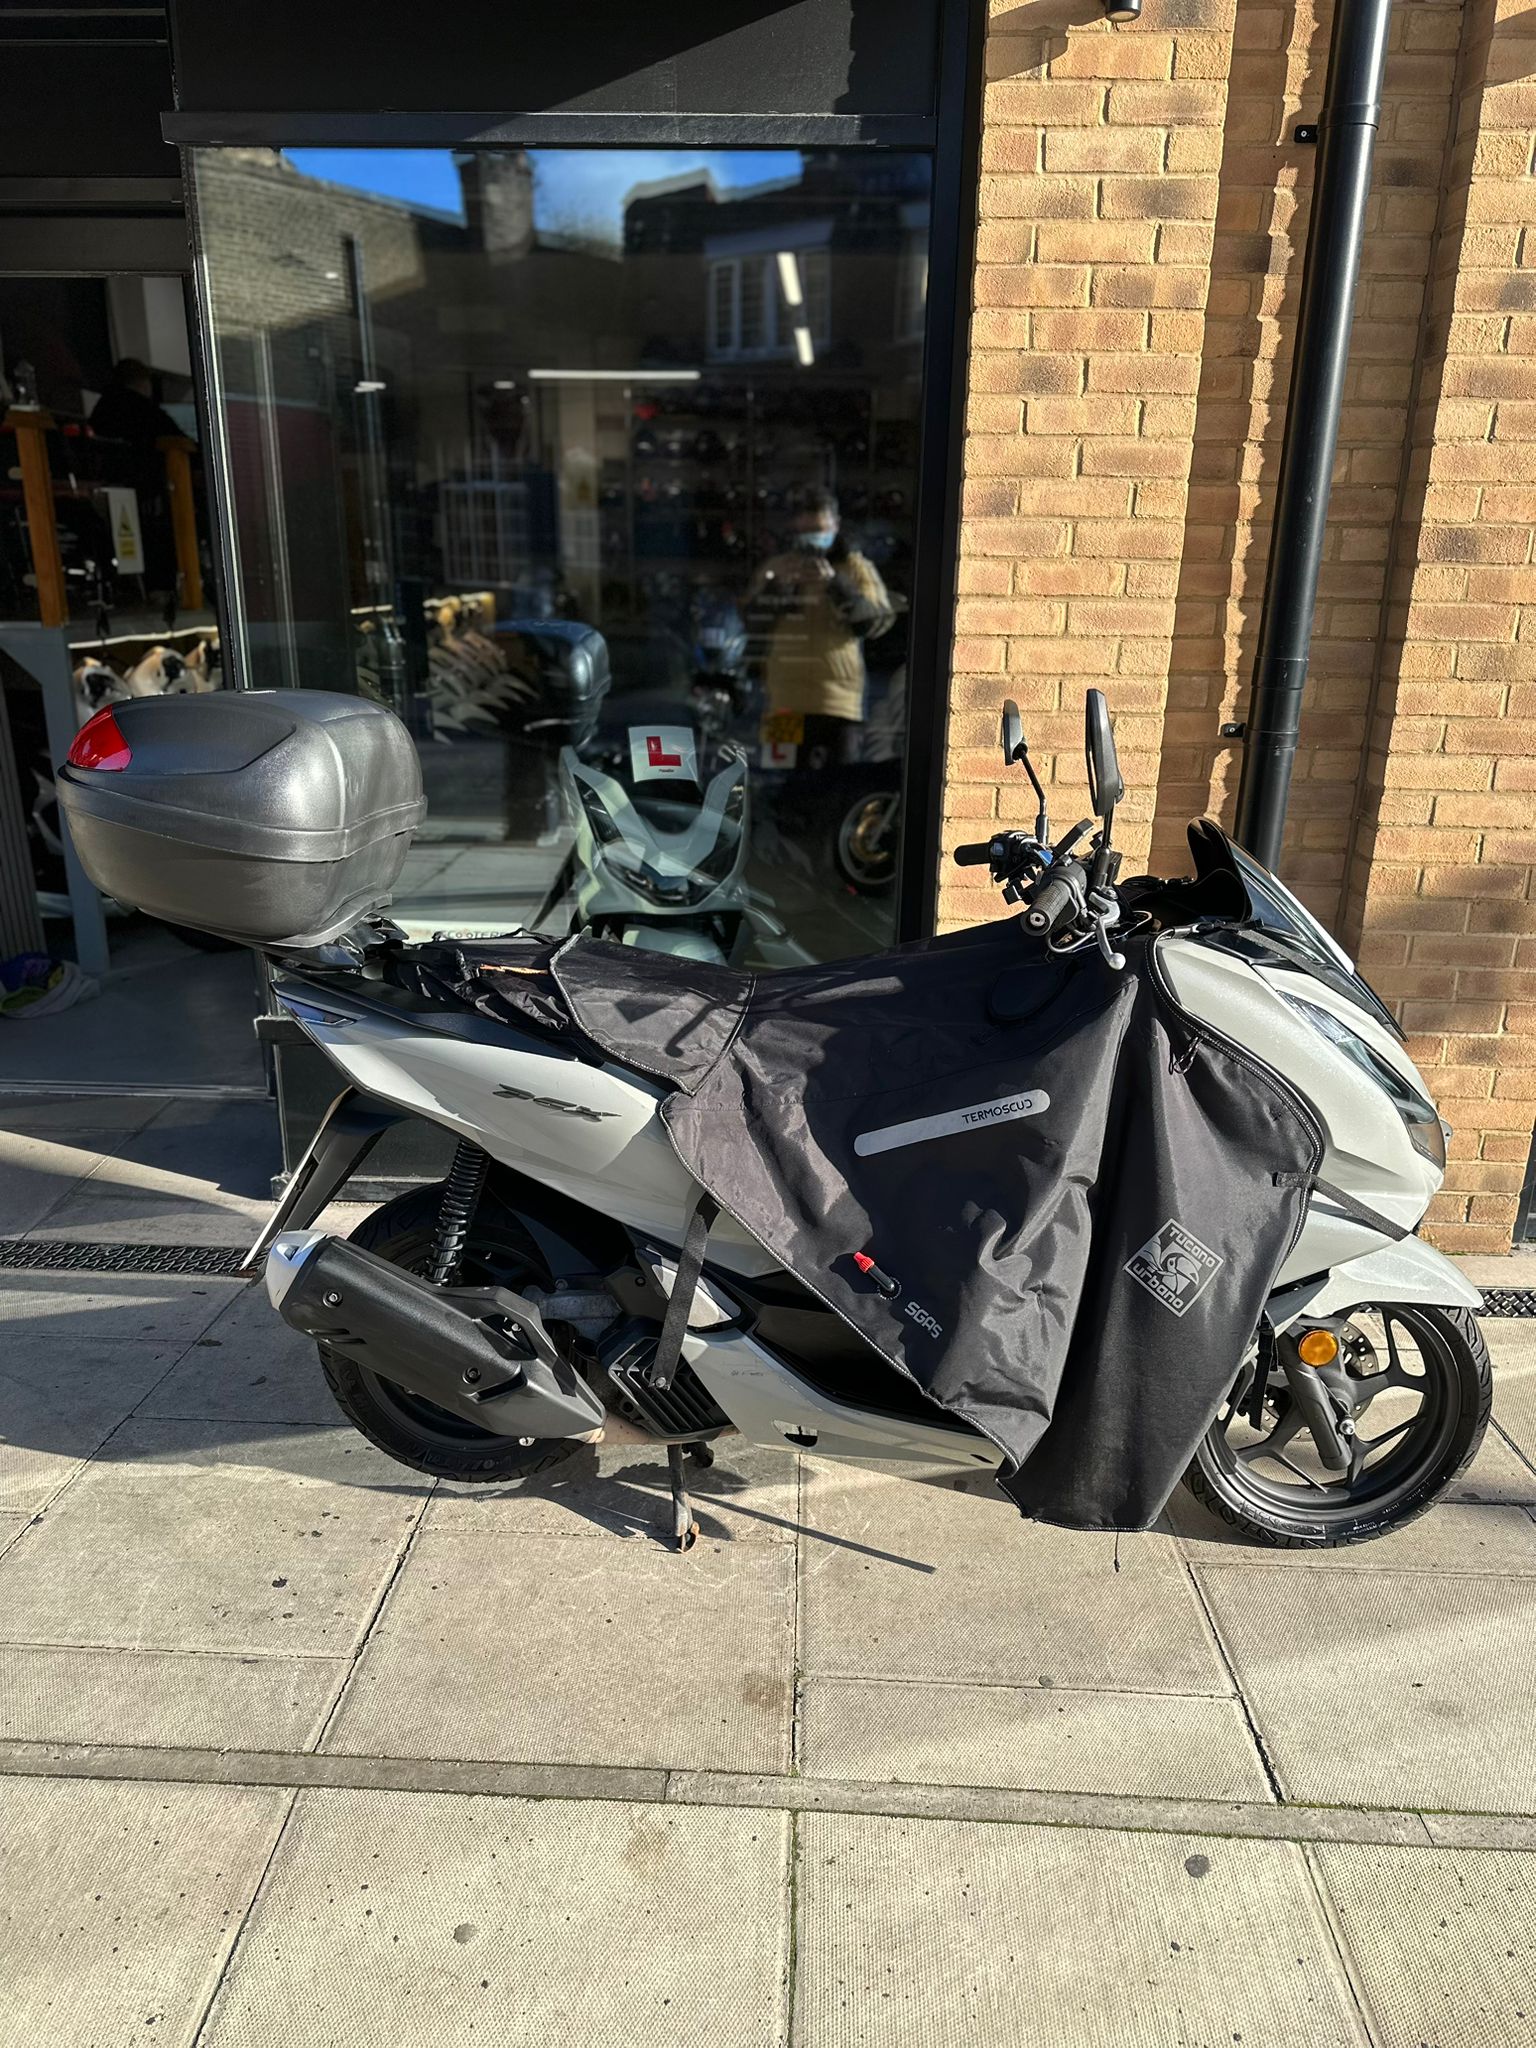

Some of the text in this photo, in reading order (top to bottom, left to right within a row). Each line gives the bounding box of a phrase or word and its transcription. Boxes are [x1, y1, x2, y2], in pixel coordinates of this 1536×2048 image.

[646, 736, 682, 767] L
[962, 1098, 1033, 1125] TERMOSCUD
[904, 1301, 943, 1339] SGAS
